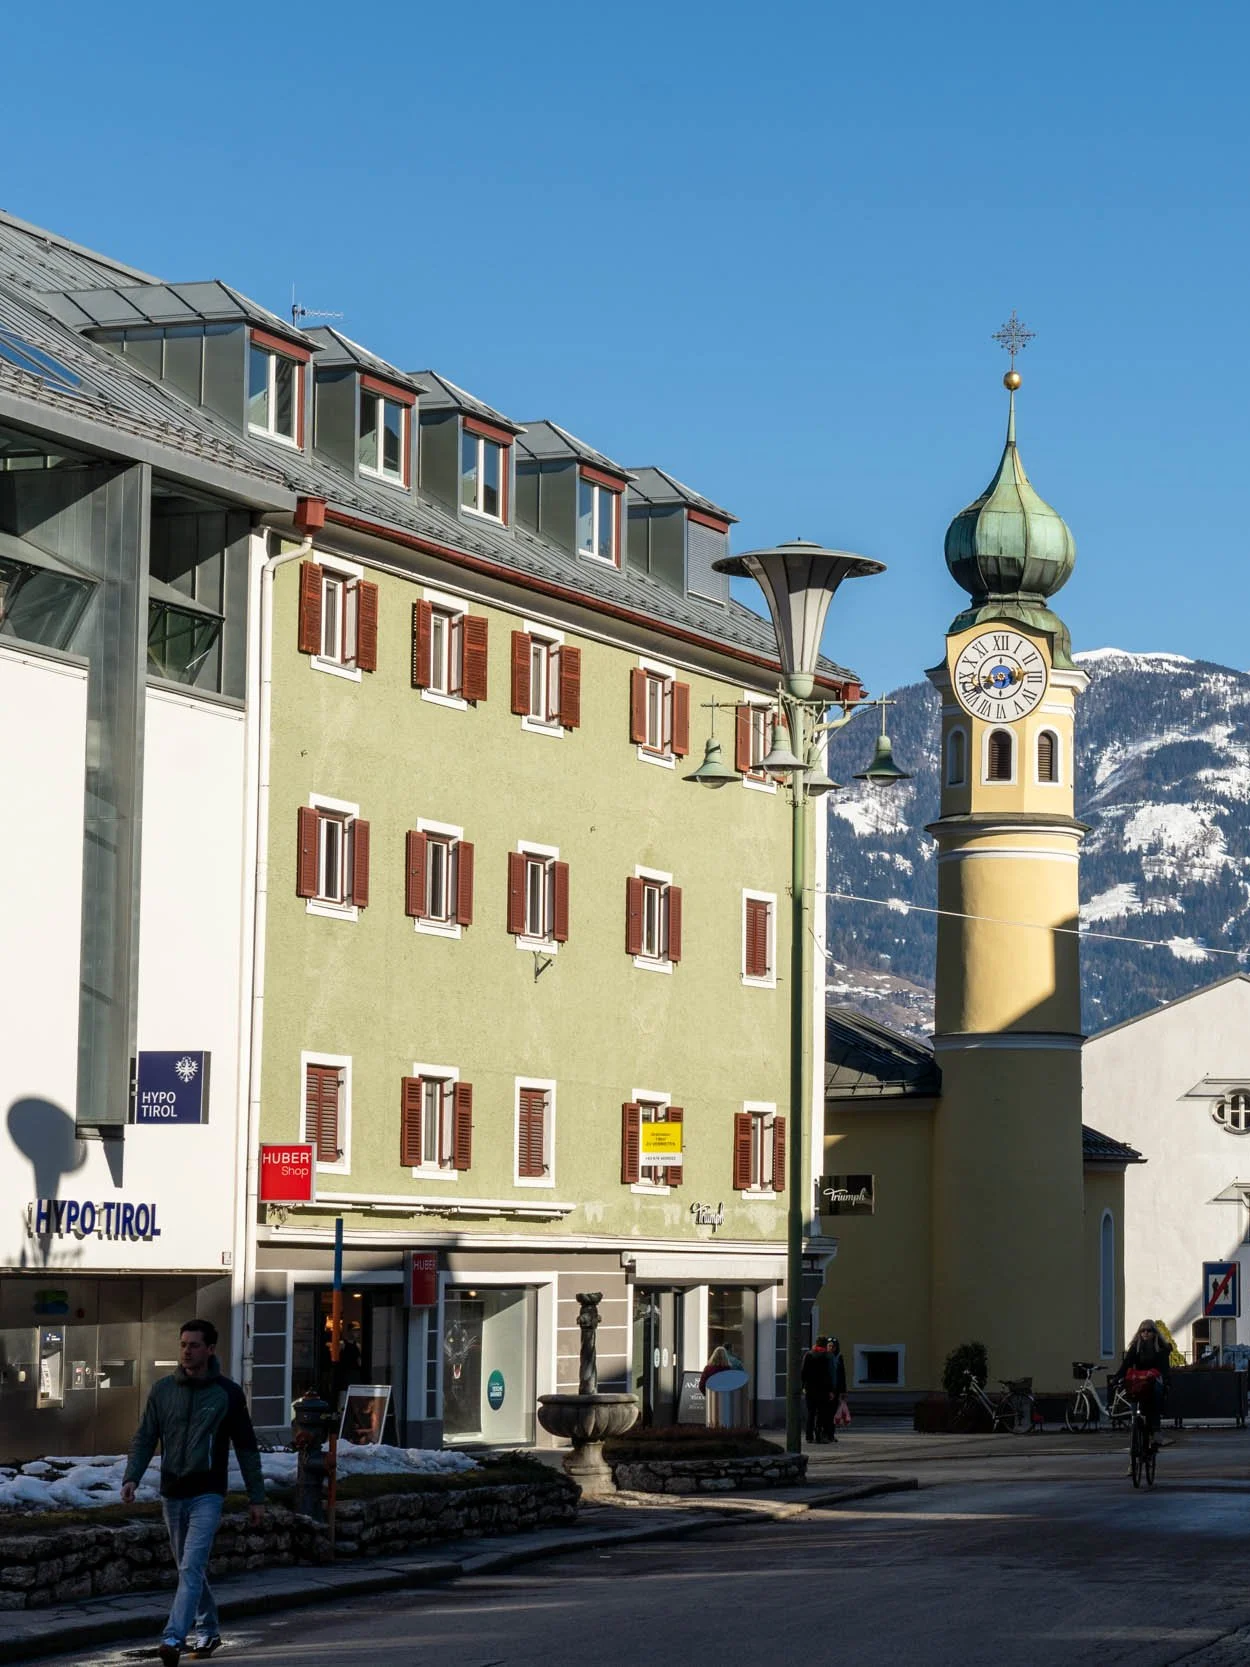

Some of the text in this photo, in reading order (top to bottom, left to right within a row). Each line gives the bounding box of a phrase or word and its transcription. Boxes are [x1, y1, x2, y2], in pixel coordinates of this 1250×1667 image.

[972, 640, 989, 658] XI
[993, 635, 1009, 651] XII
[1013, 640, 1023, 654] I
[962, 656, 978, 669] X
[1022, 652, 1038, 666] II
[1026, 670, 1042, 683] III
[1021, 688, 1037, 705] IV
[977, 699, 991, 717] VII
[996, 703, 1007, 719] VI
[1013, 700, 1025, 715] V
[142, 1092, 176, 1104] HYPO
[142, 1105, 178, 1118] TIROL
[262, 1152, 310, 1164] HUBER
[281, 1165, 309, 1179] Shop
[823, 1187, 867, 1206] Triumph
[36, 1199, 161, 1237] HYPO TIROL
[690, 1200, 724, 1234] Triumph
